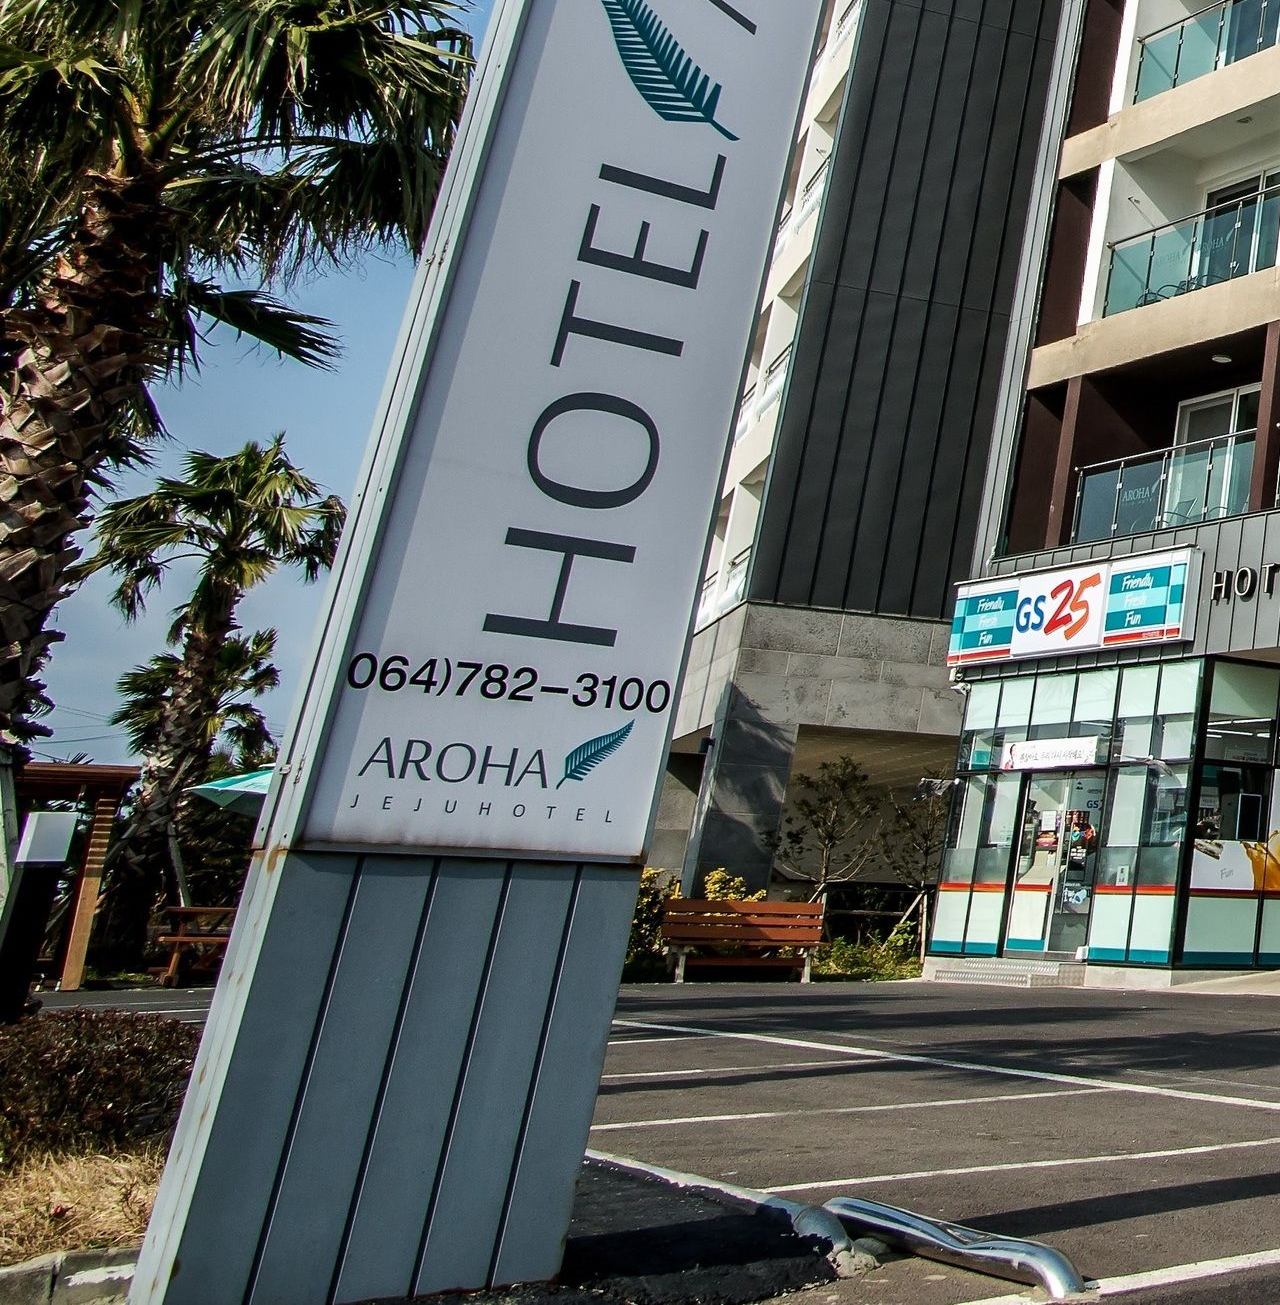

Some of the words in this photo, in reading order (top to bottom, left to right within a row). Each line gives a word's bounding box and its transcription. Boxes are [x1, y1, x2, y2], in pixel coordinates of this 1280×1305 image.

[483, 154, 726, 647] HOTEL
[1121, 571, 1154, 590] Friendly
[976, 596, 1004, 613] Friendly
[1015, 572, 1102, 641] GS25
[1123, 592, 1147, 607] Fresh
[977, 615, 998, 628] Fresh
[1124, 610, 1141, 627] Fun
[977, 630, 993, 646] Fun
[347, 652, 670, 714] 064)782-3100
[358, 736, 548, 789] AROHA
